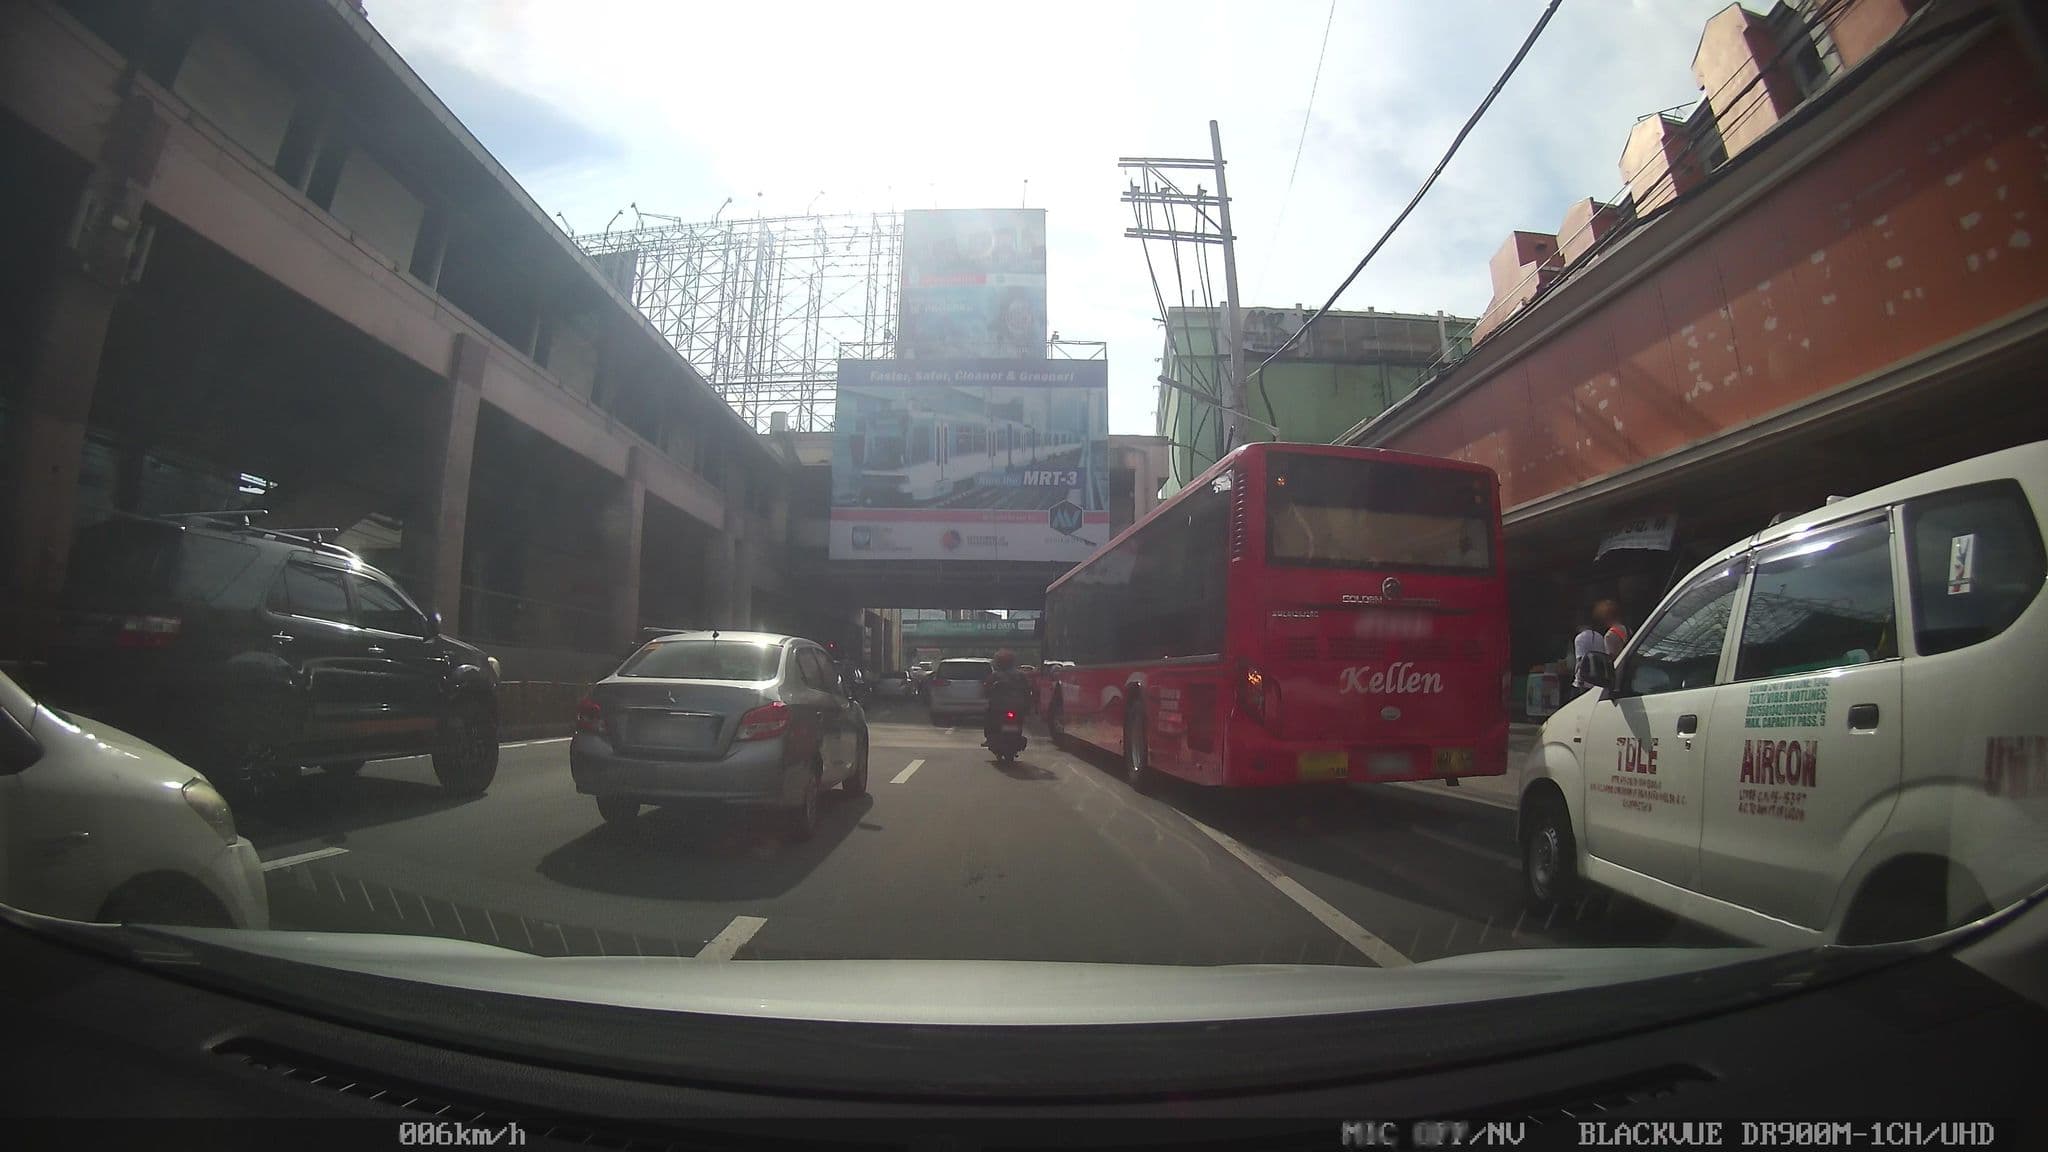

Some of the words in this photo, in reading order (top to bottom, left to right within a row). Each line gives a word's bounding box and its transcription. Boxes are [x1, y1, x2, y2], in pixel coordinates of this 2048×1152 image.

[1023, 470, 1078, 486] MRT-3
[1340, 662, 1443, 694] Kellen
[1740, 739, 1818, 788] AIRCON
